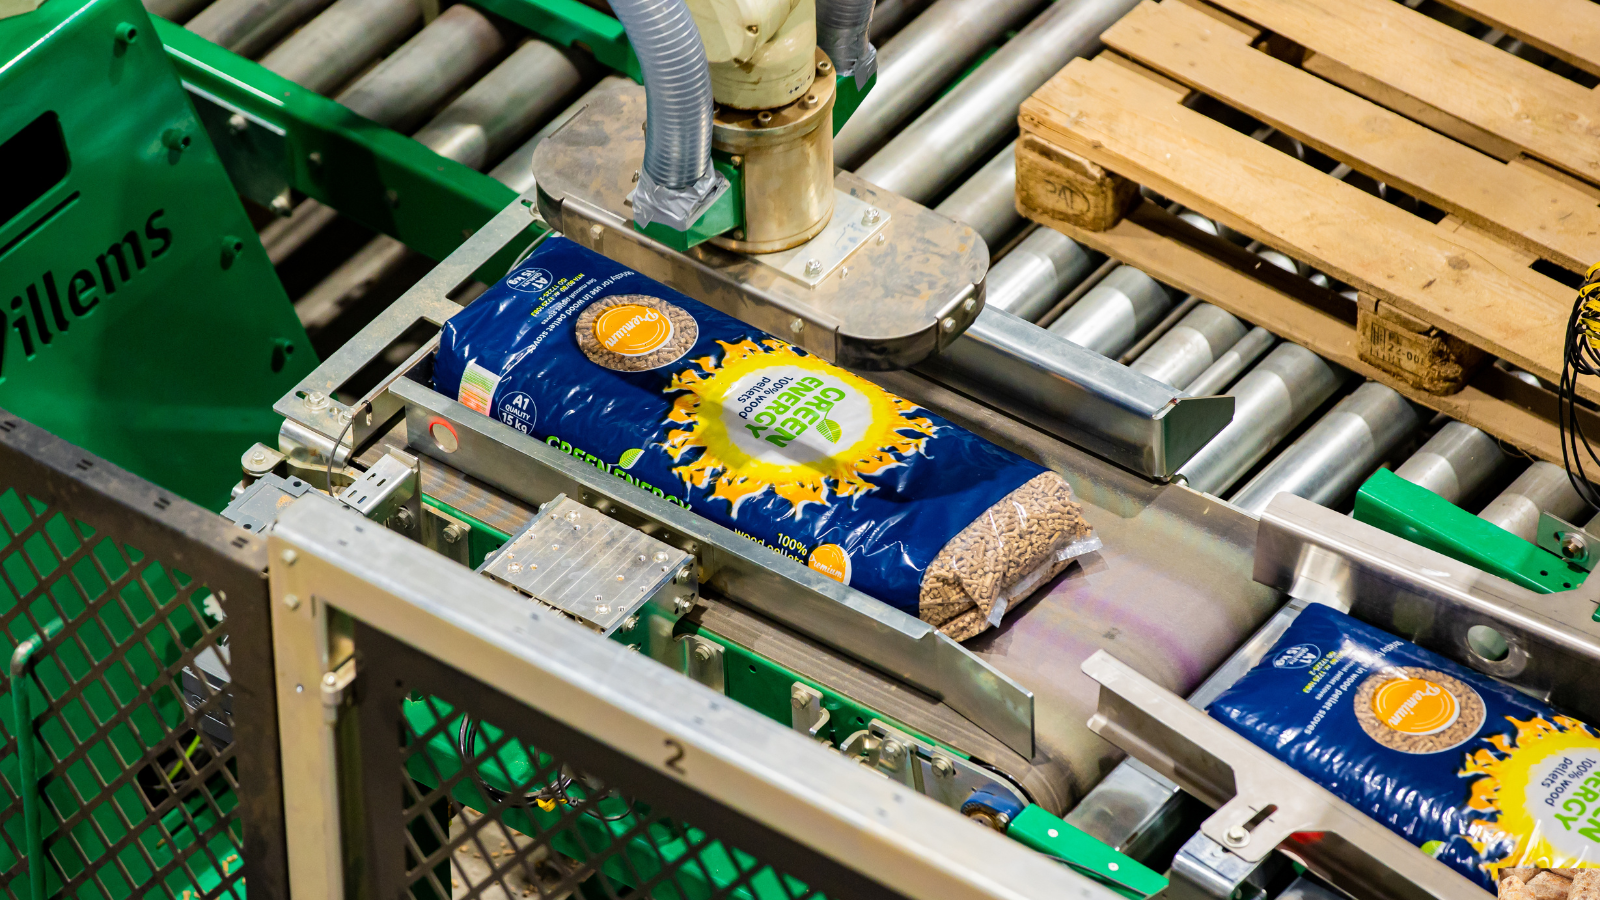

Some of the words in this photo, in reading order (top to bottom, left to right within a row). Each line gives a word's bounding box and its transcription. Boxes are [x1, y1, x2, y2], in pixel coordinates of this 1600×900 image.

[508, 275, 524, 285] kg
[521, 269, 536, 278] 15
[532, 276, 549, 289] A1
[601, 278, 614, 288] for
[0, 207, 173, 378] illems
[583, 292, 594, 301] in
[589, 285, 604, 295] use
[565, 298, 586, 316] wood
[546, 313, 567, 332] pellet
[604, 308, 659, 349] Premium
[737, 376, 771, 404] pellets
[764, 376, 794, 395] 100%
[505, 404, 531, 421] QUALITY
[512, 394, 530, 411] A1
[738, 393, 767, 420] wood
[744, 376, 825, 439] ENERGY
[502, 412, 514, 426] 15
[514, 419, 528, 435] kg
[764, 387, 846, 448] GREEN
[777, 532, 808, 556] 100%
[808, 553, 843, 580] Premium
[1339, 673, 1360, 692] wood
[1387, 682, 1441, 728] Premium
[1303, 709, 1327, 736] stoves
[663, 738, 687, 775] 2
[1567, 757, 1597, 779] 100%
[1541, 756, 1573, 788] pellets
[1544, 779, 1573, 807] wood
